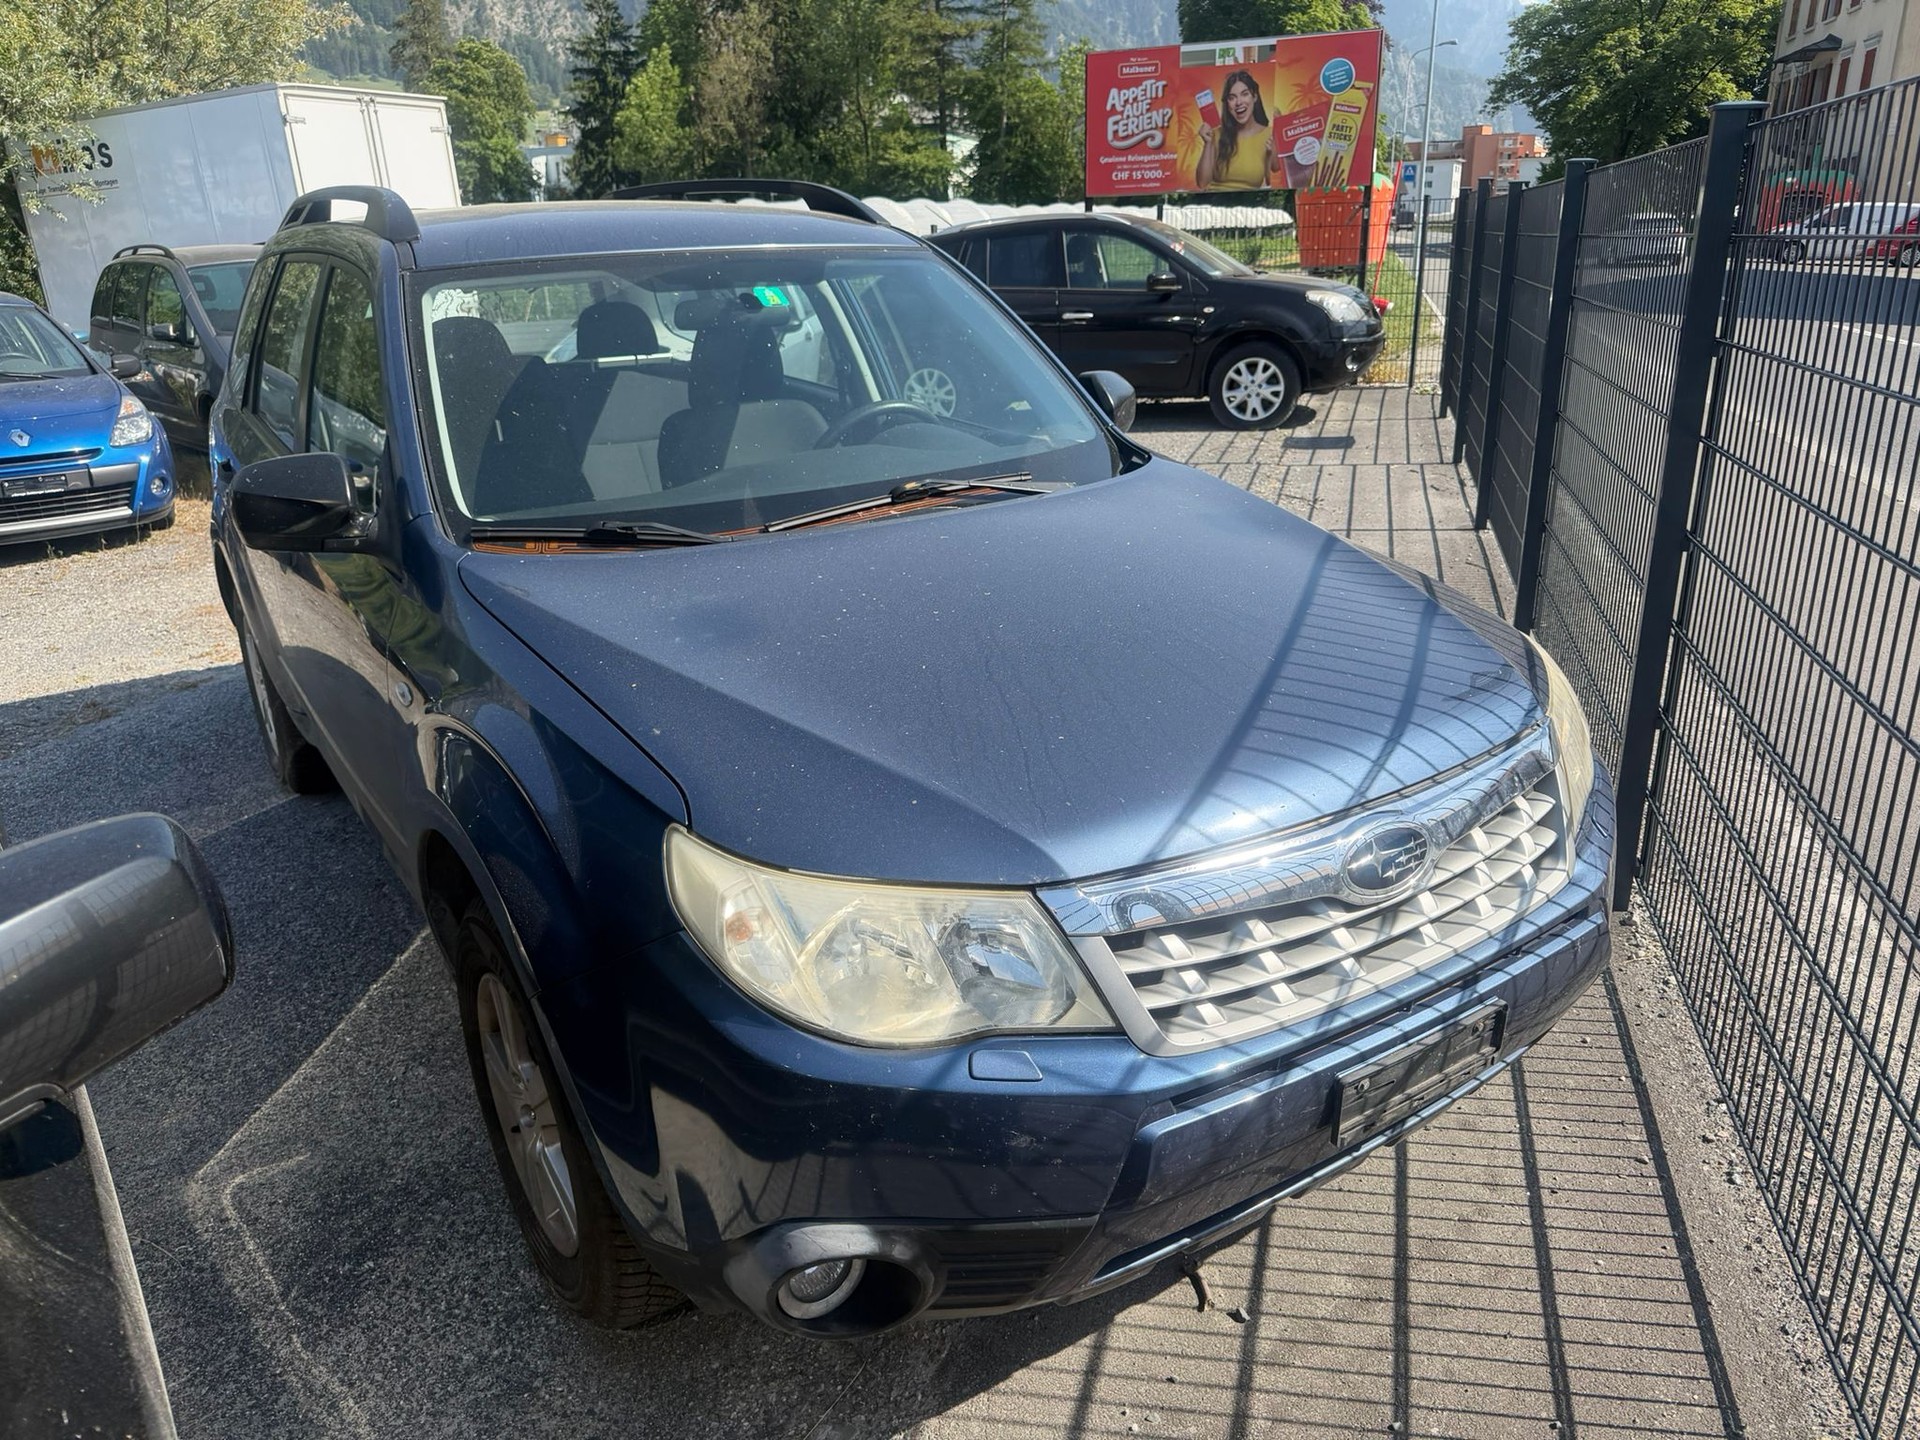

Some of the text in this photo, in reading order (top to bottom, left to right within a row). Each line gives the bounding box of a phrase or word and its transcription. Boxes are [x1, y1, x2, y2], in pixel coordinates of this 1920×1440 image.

[1122, 66, 1156, 75] Malbuner
[1106, 79, 1167, 111] APPETIT
[1123, 99, 1151, 119] AUF
[1107, 108, 1173, 148] FERIEN?
[1286, 121, 1321, 137] Malbuner
[1331, 124, 1354, 132] PARTY
[1328, 132, 1353, 141] STICKS
[1099, 156, 1126, 164] Gewinne
[1112, 171, 1131, 180] CHF
